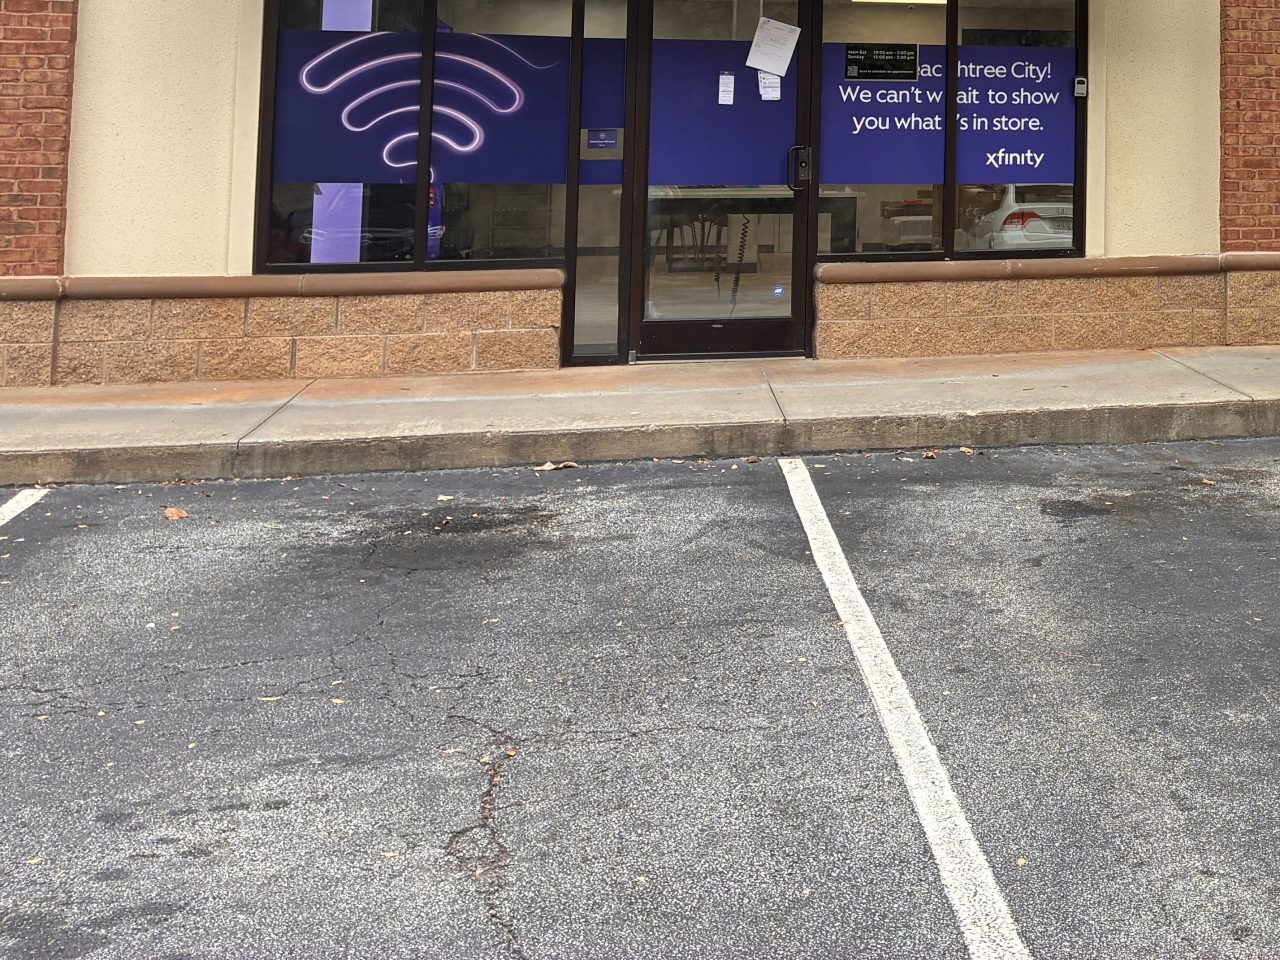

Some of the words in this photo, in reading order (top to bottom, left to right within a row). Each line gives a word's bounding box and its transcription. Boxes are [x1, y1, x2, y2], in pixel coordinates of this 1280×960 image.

[917, 61, 1007, 78] achtree
[1011, 61, 1051, 82] City!
[839, 85, 872, 103] We
[876, 86, 922, 104] can't
[988, 88, 1008, 104] to
[1011, 88, 1059, 105] show
[852, 116, 890, 134] you
[972, 113, 988, 130] in
[992, 115, 1044, 131] store.
[986, 148, 1045, 168] xfinity
